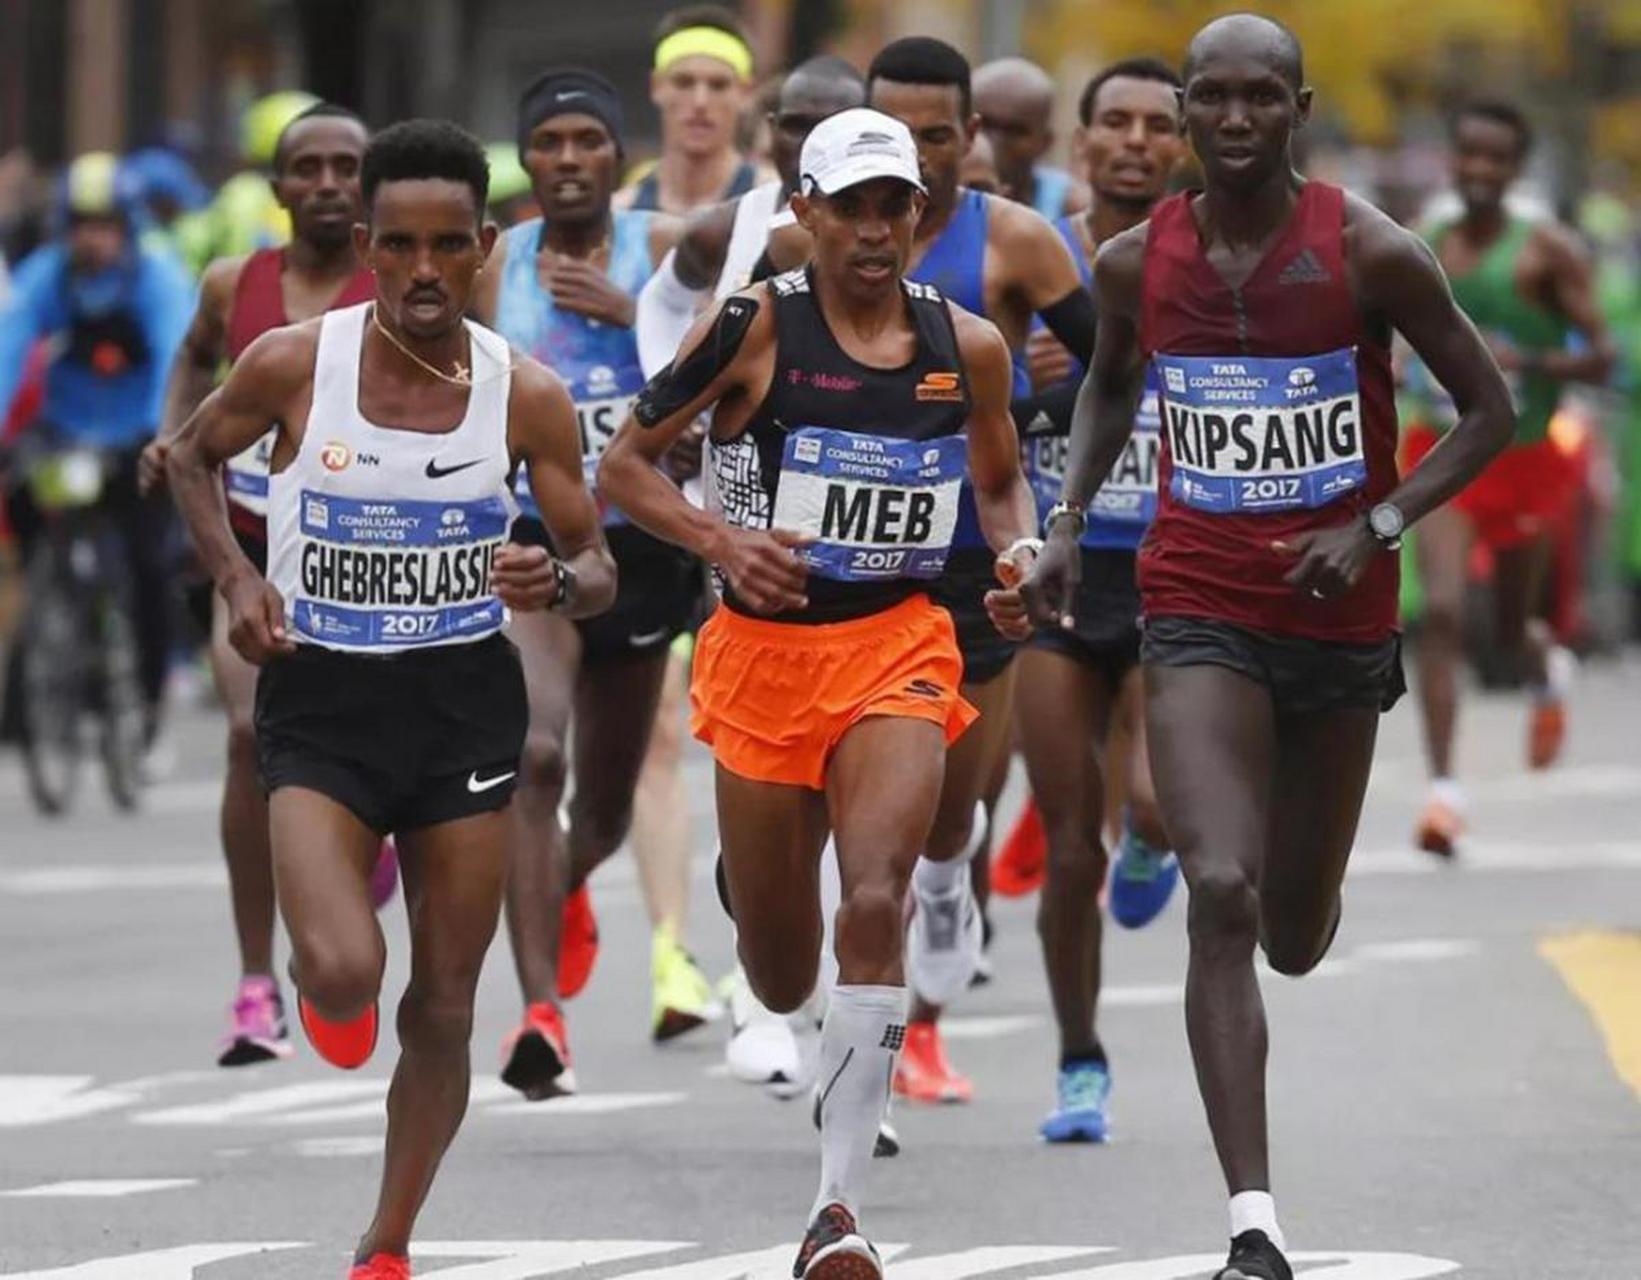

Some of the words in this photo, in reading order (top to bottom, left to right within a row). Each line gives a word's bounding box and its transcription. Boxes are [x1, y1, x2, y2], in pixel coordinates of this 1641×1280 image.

[1211, 364, 1247, 375] TATA
[1189, 377, 1269, 388] CONSULTANCY
[1204, 390, 1256, 401] SERVICES
[1285, 386, 1318, 399] TATA
[1169, 401, 1357, 470] KIPSANG
[852, 439, 885, 453] TATA
[826, 447, 904, 469] CONSULTANCY
[840, 463, 890, 478] SERVICES
[1242, 478, 1302, 500] 2017
[361, 505, 397, 516] TATA
[819, 484, 936, 544] MEB
[337, 515, 421, 530] CONSULTANCY
[352, 528, 405, 541] SERVICES
[436, 527, 470, 539] TATA
[851, 552, 904, 569] 2017
[382, 615, 440, 634] 2017
